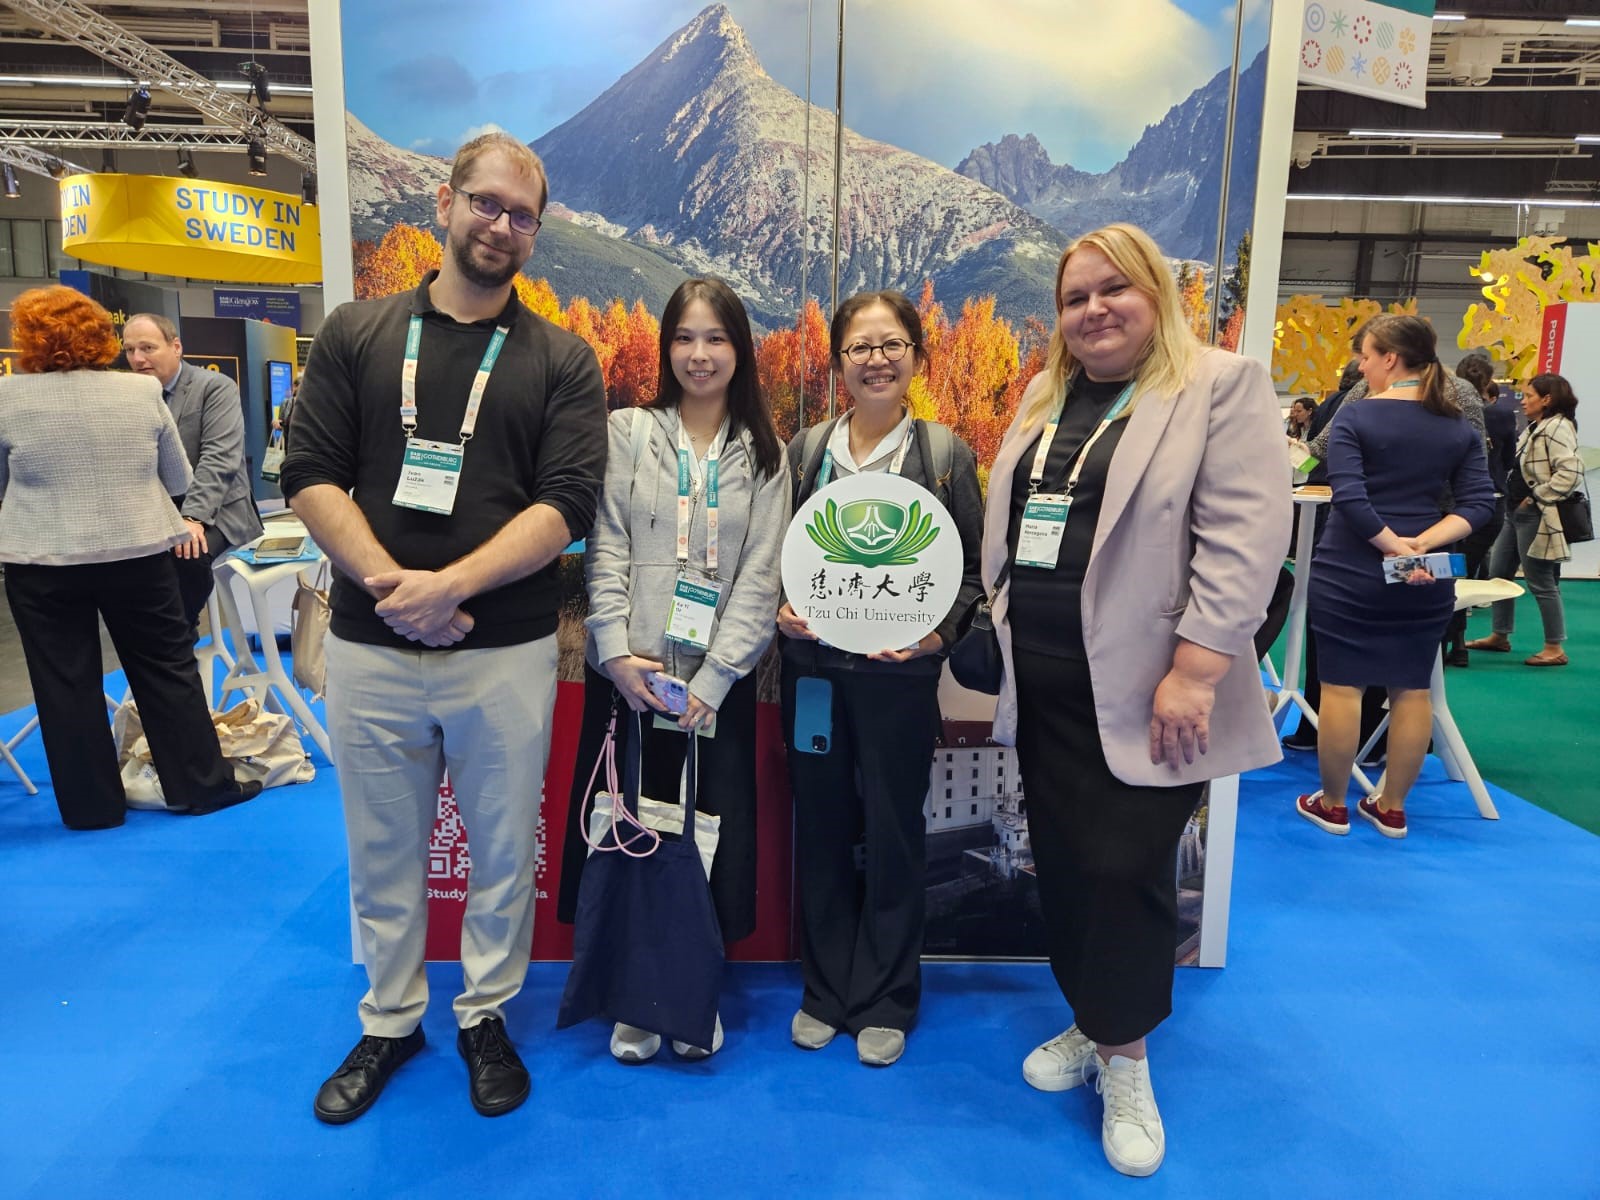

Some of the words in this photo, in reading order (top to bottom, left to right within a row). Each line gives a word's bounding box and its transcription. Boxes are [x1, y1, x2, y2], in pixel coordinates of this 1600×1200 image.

[72, 184, 90, 207] IN
[176, 187, 265, 218] STUDY
[273, 201, 301, 226] IN
[185, 218, 295, 251] SWEDEN
[809, 568, 935, 602] 慈濟大學
[805, 605, 830, 619] Tzu
[836, 607, 858, 620] Chi
[864, 609, 935, 625] University
[427, 888, 467, 902] Study
